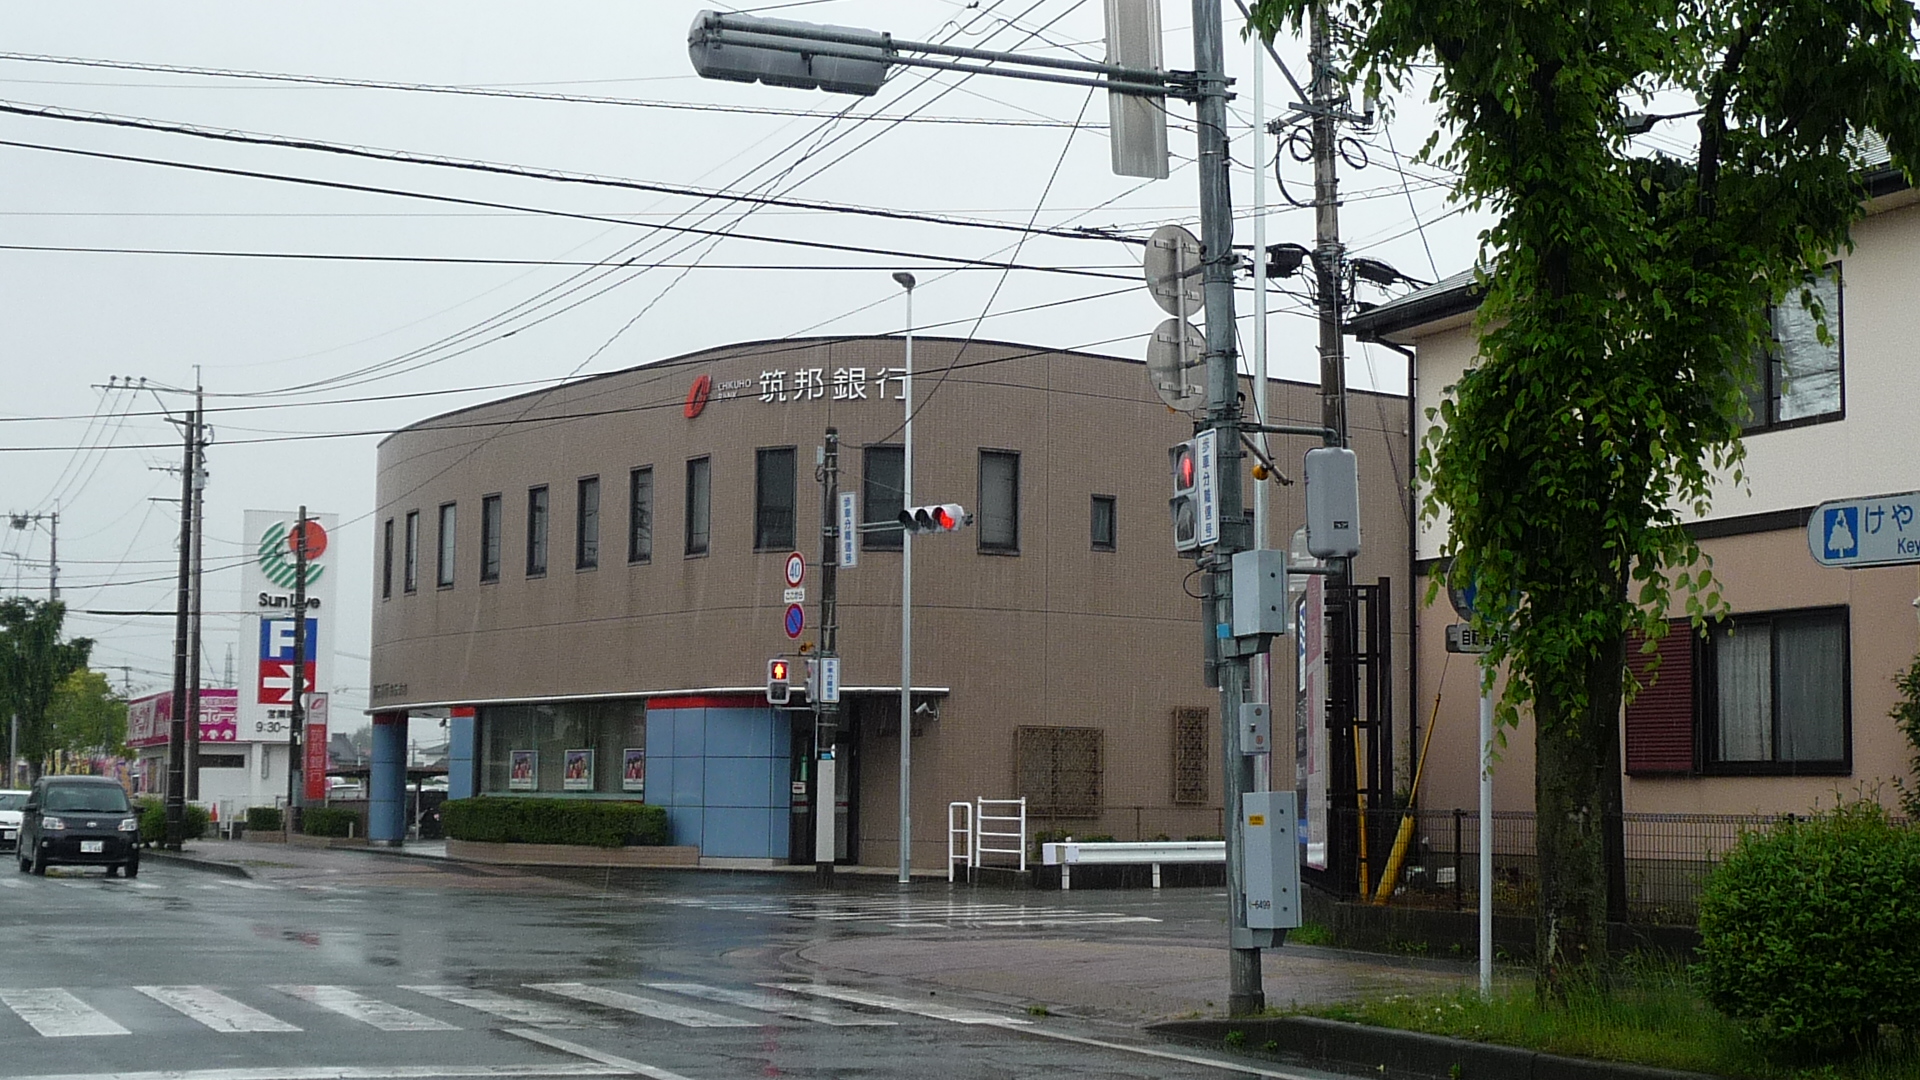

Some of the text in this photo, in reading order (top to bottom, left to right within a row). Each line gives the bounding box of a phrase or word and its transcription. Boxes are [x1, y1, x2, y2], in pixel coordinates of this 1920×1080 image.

[758, 366, 907, 403] 筑邦銀行
[1864, 503, 1914, 535] けや
[789, 561, 801, 579] 40
